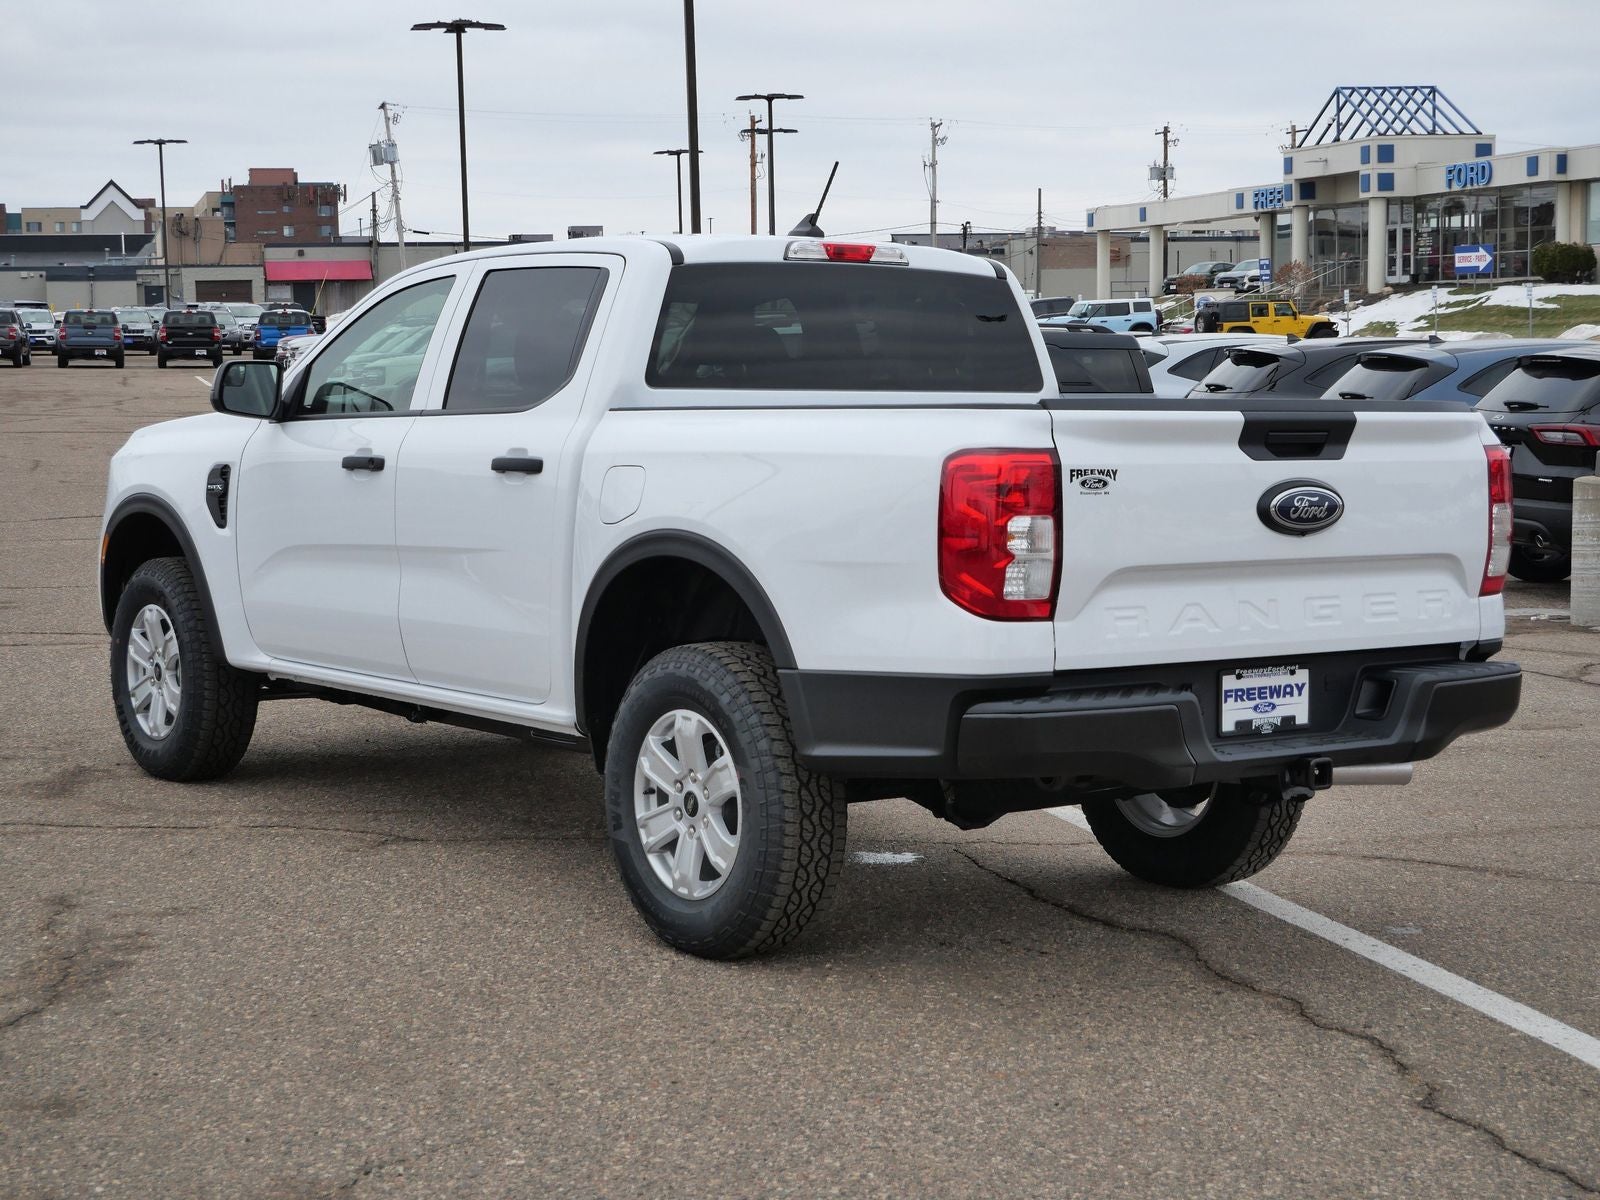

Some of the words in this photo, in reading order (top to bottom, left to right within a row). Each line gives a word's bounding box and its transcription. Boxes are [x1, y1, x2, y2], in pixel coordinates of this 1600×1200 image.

[1446, 160, 1492, 190] FORD
[1457, 255, 1472, 263] SERVICE
[1475, 254, 1487, 262] PARTS
[1069, 468, 1118, 483] FREEWAY
[1084, 479, 1103, 489] Ford
[1290, 495, 1329, 519] Ford
[1104, 589, 1452, 639] RANGER
[1224, 683, 1306, 703] FREEWAY
[1256, 703, 1272, 713] Ford
